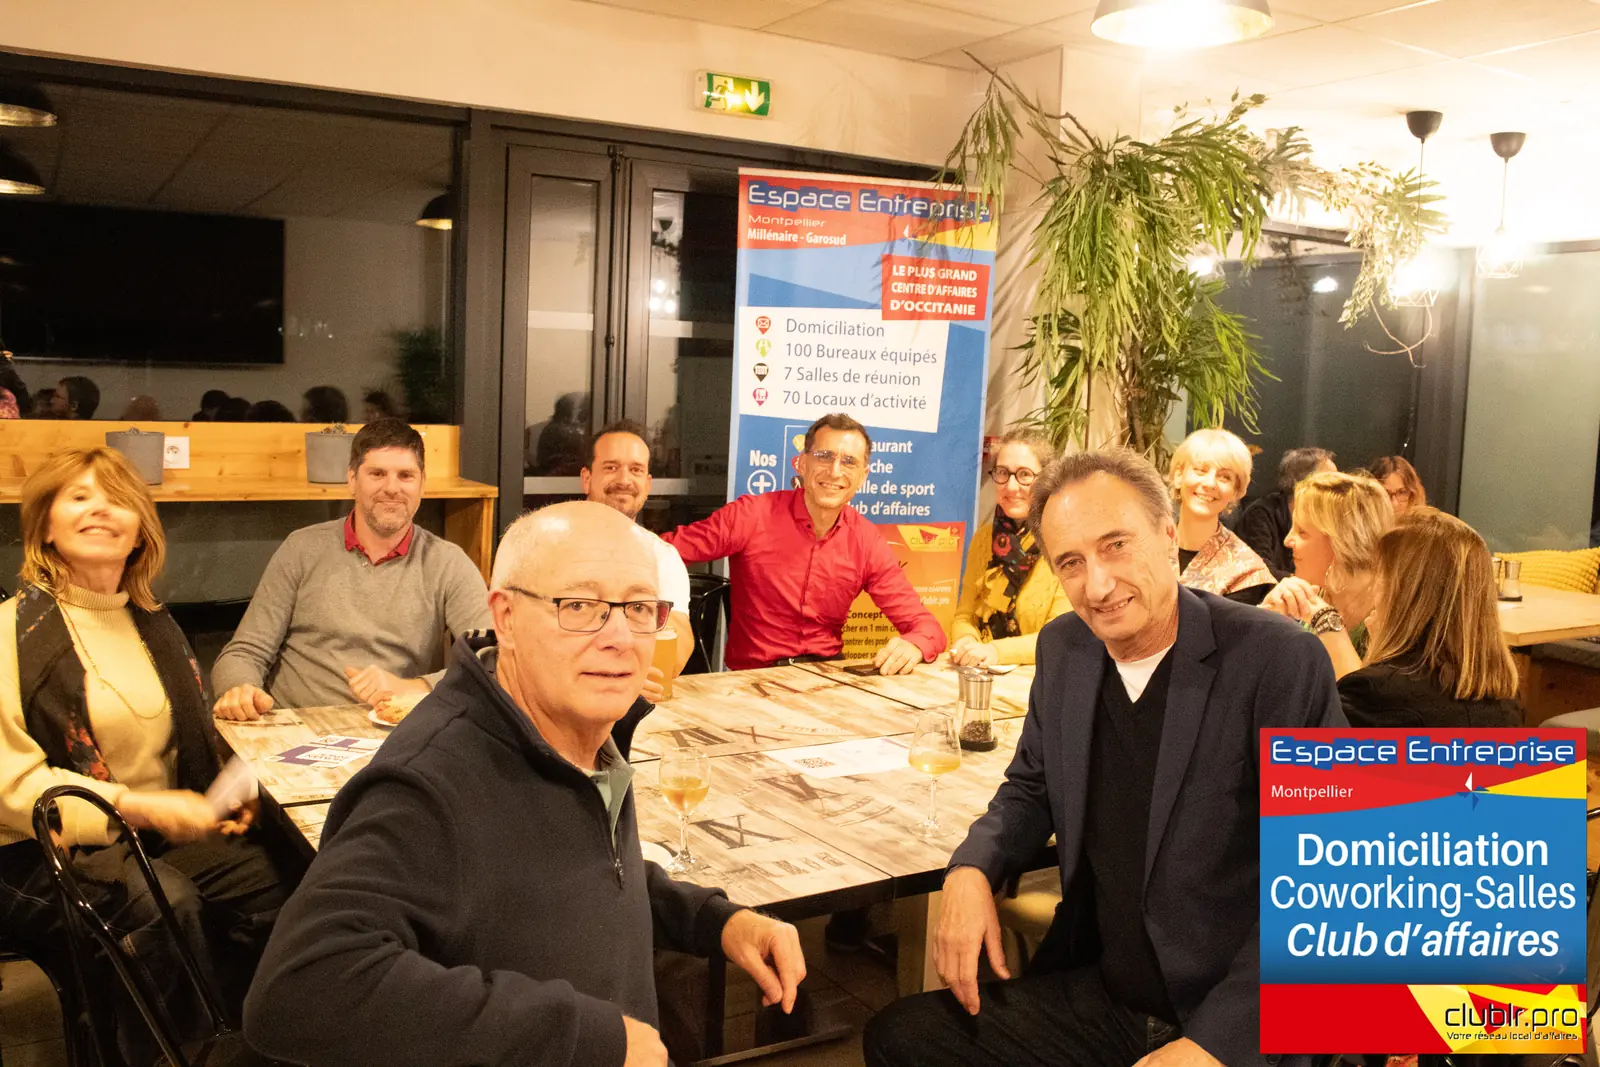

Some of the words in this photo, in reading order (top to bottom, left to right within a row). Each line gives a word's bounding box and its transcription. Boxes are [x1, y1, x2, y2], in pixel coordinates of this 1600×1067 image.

[749, 184, 850, 208] Espace
[860, 192, 989, 220] Entreprise
[748, 214, 826, 228] Montpellier
[748, 228, 798, 242] Millénaire
[806, 231, 846, 246] Garosud
[892, 265, 905, 276] LE
[908, 266, 935, 278] PLUS
[937, 268, 977, 281] GRAND
[891, 282, 926, 295] CENTRE
[927, 284, 977, 298] D'AFFAIRES
[890, 300, 975, 315] D'OCCITANIE
[787, 319, 884, 337] Domiciliation
[786, 343, 812, 358] 100
[817, 344, 876, 361] Bureaux
[881, 347, 937, 366] équipés
[784, 367, 792, 381] 7
[797, 367, 838, 383] Salles
[843, 368, 860, 384] de
[865, 369, 920, 386] réunion
[783, 390, 800, 404] 70
[805, 391, 856, 407] Locaux
[860, 393, 927, 410] d'activité
[870, 440, 913, 454] aurant
[750, 450, 777, 467] Nos
[868, 459, 893, 473] che
[881, 480, 897, 494] de
[900, 483, 935, 498] sport
[870, 501, 931, 516] d'affaires
